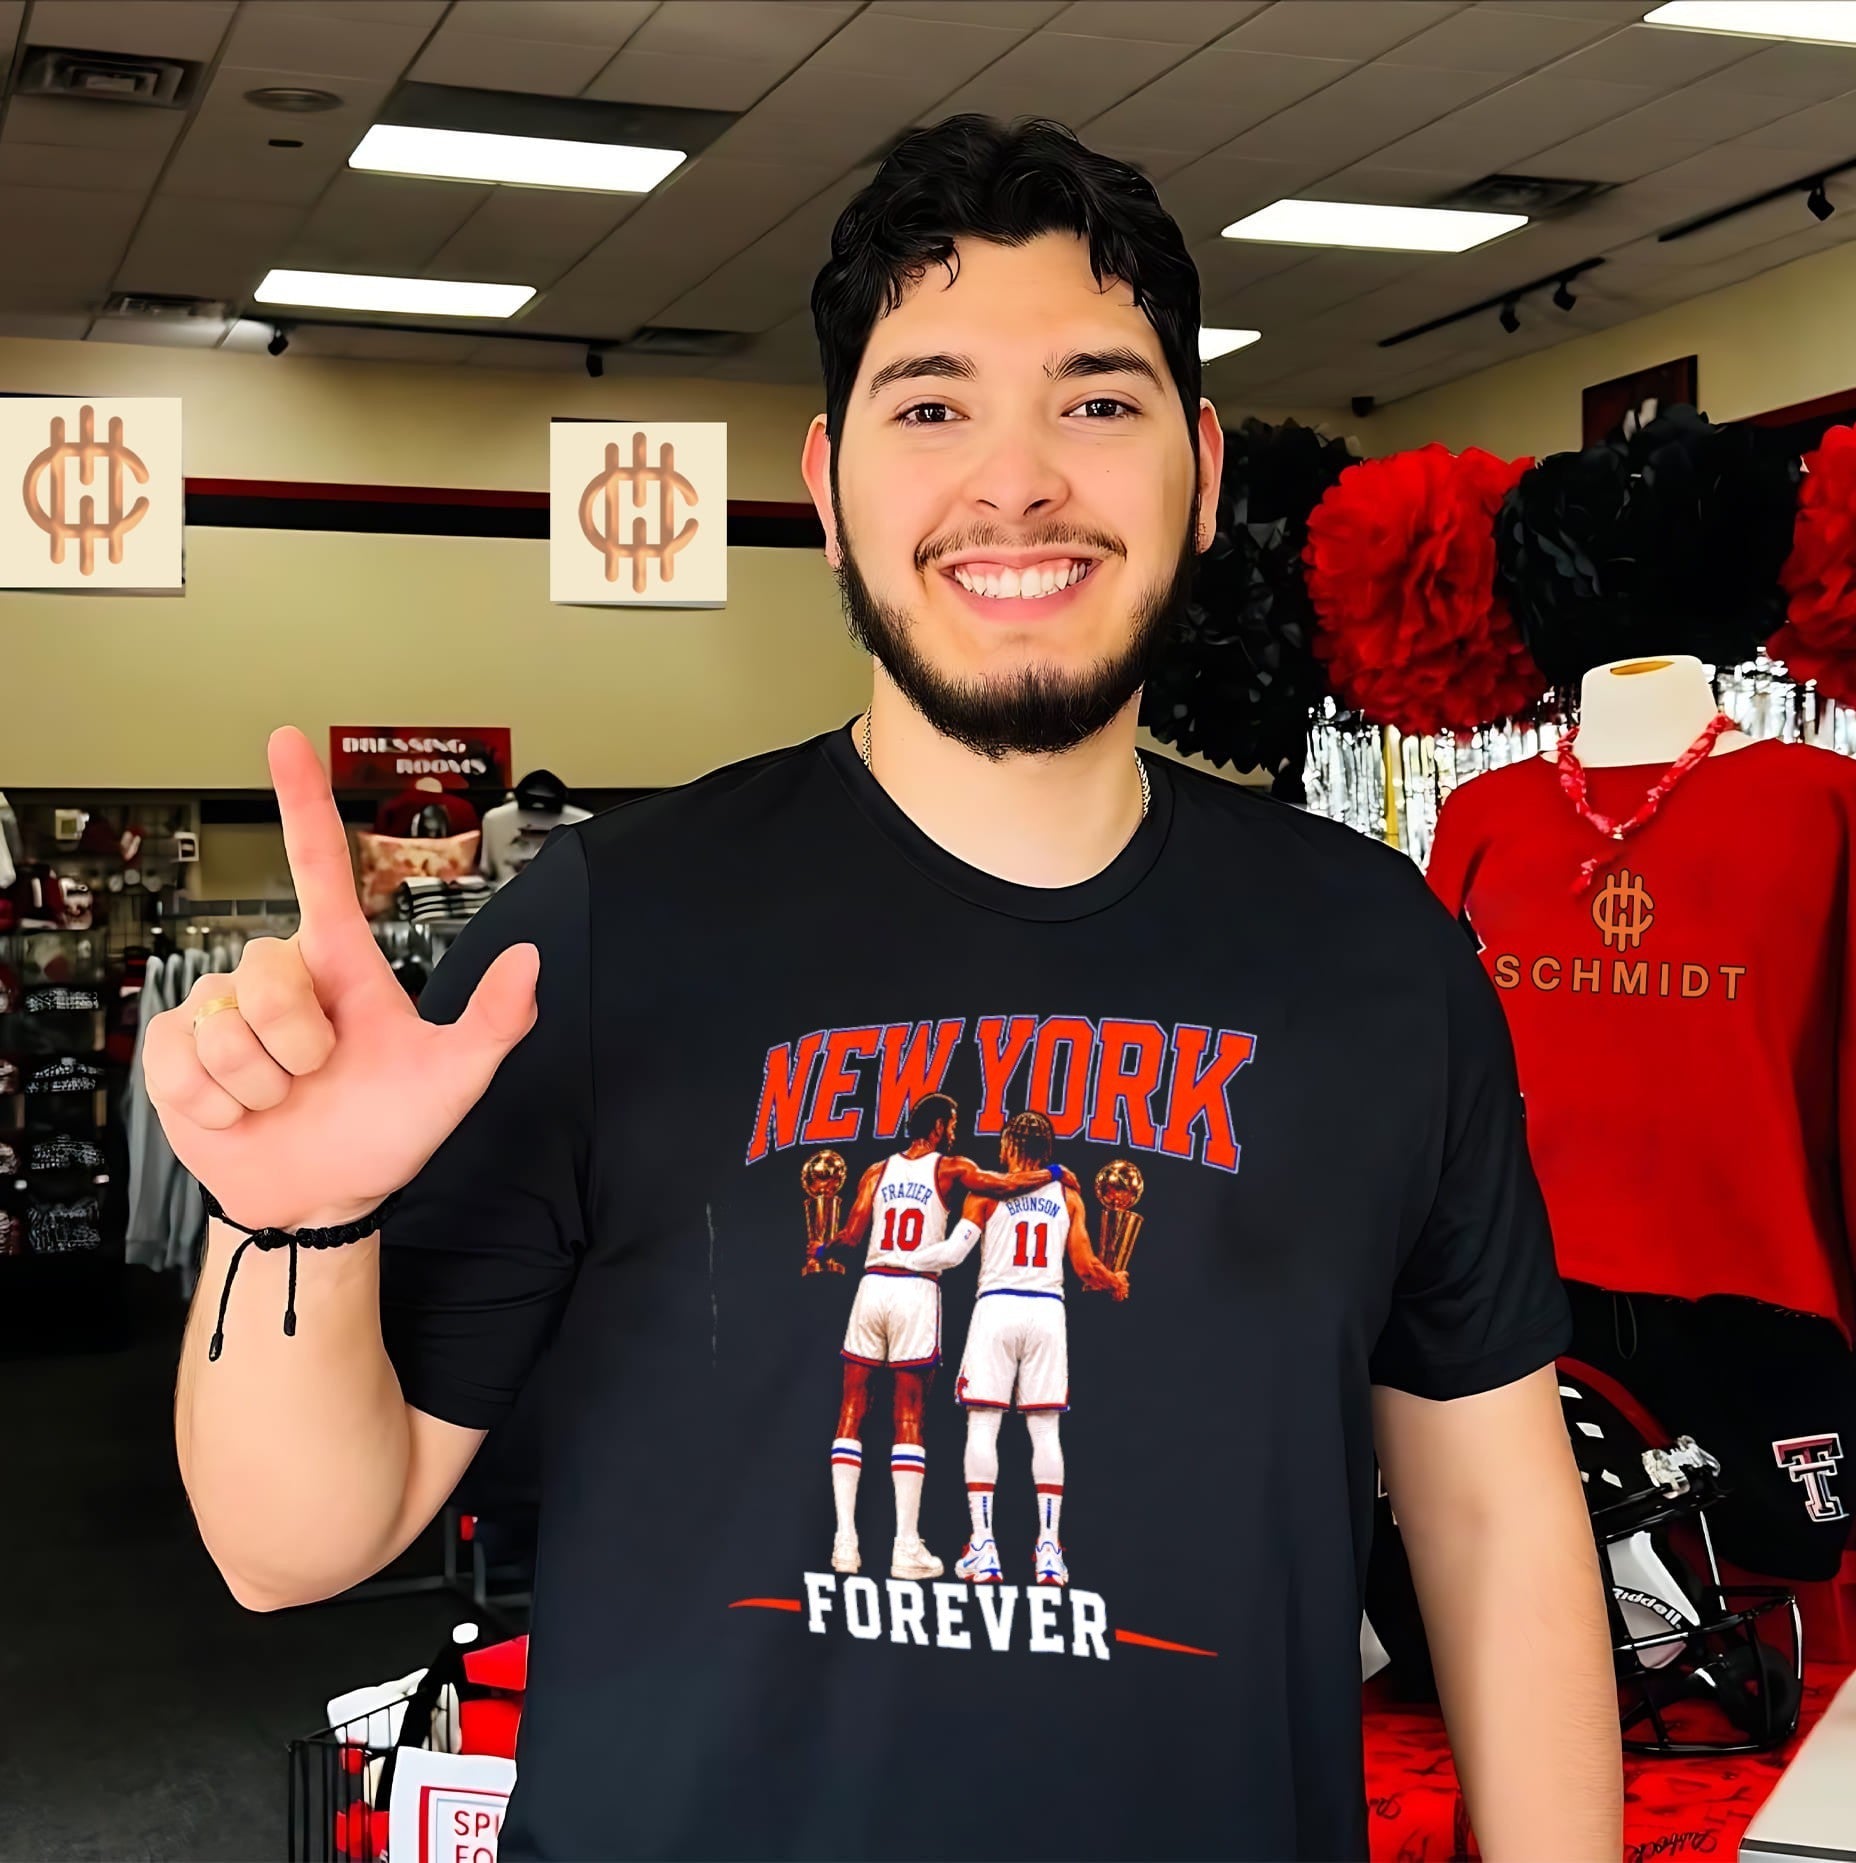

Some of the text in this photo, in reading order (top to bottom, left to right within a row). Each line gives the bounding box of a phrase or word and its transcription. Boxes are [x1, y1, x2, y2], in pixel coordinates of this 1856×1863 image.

[396, 758, 487, 775] ROOMS
[1494, 953, 1747, 1001] SCHMIDT
[746, 1015, 1258, 1174] NEW YORK
[881, 1182, 934, 1206] FRAZIER
[1005, 1197, 1062, 1219] BRUNSON
[880, 1207, 925, 1251] 10
[1013, 1221, 1048, 1268] 11
[803, 1571, 1111, 1661] FOREVER
